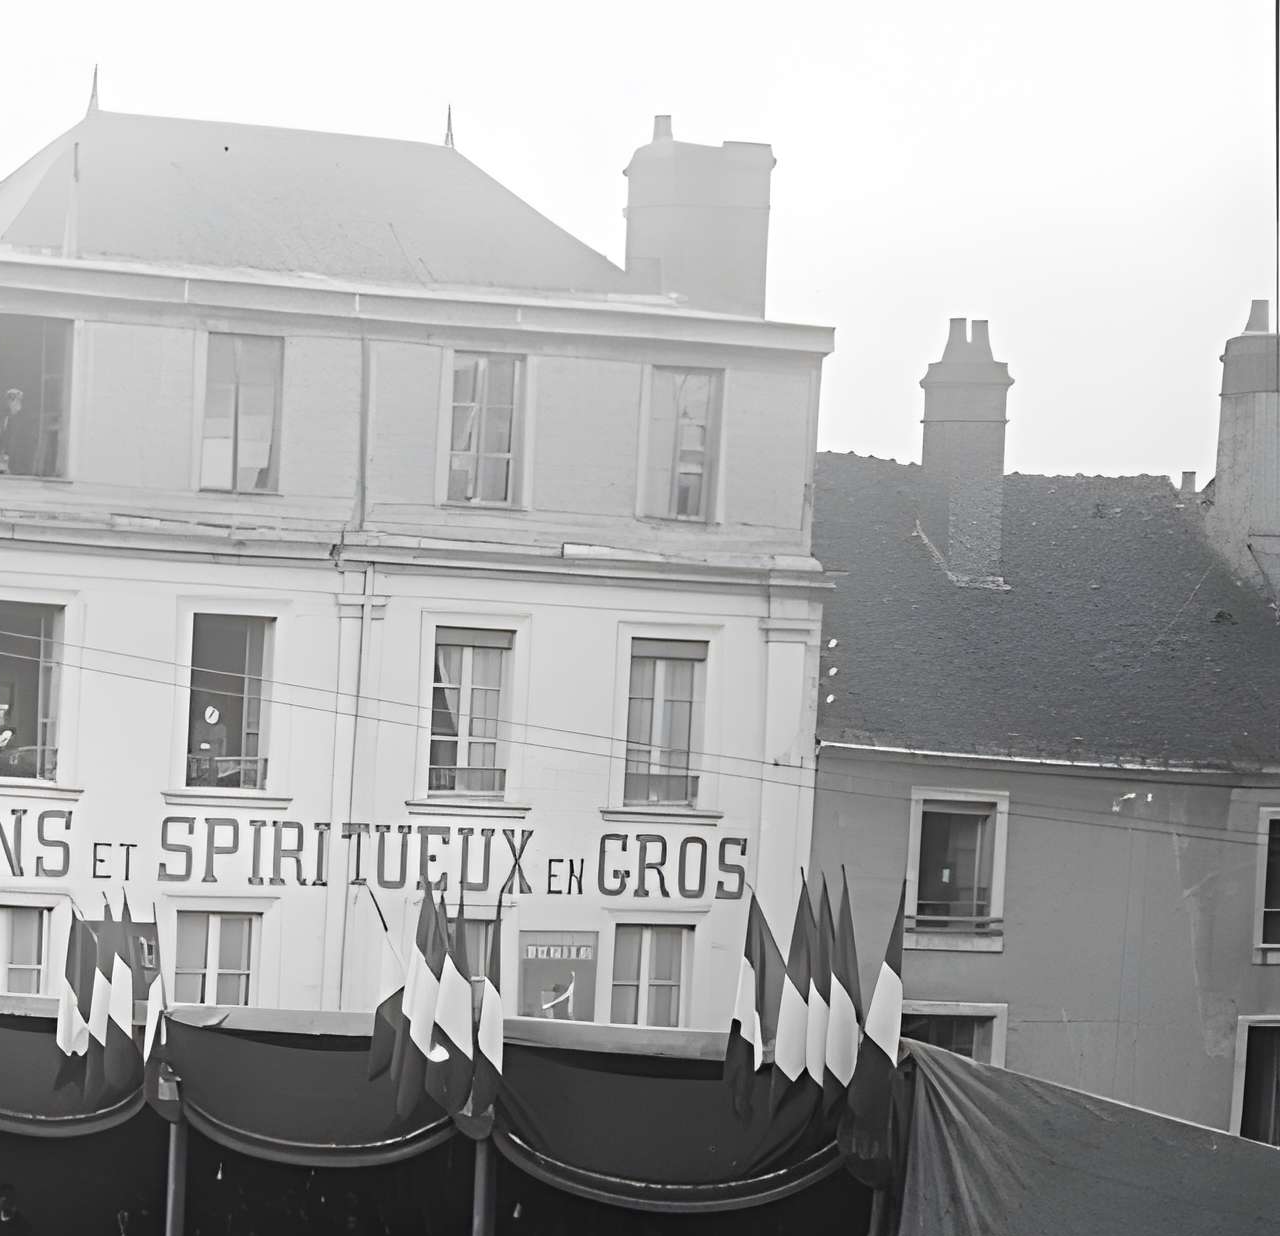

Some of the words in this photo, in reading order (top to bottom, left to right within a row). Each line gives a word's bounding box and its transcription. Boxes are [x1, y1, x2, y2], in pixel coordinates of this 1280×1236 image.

[91, 842, 139, 881] ET
[156, 816, 535, 895] SPIRITUEUX
[546, 857, 585, 895] EN
[597, 833, 748, 899] GROS
